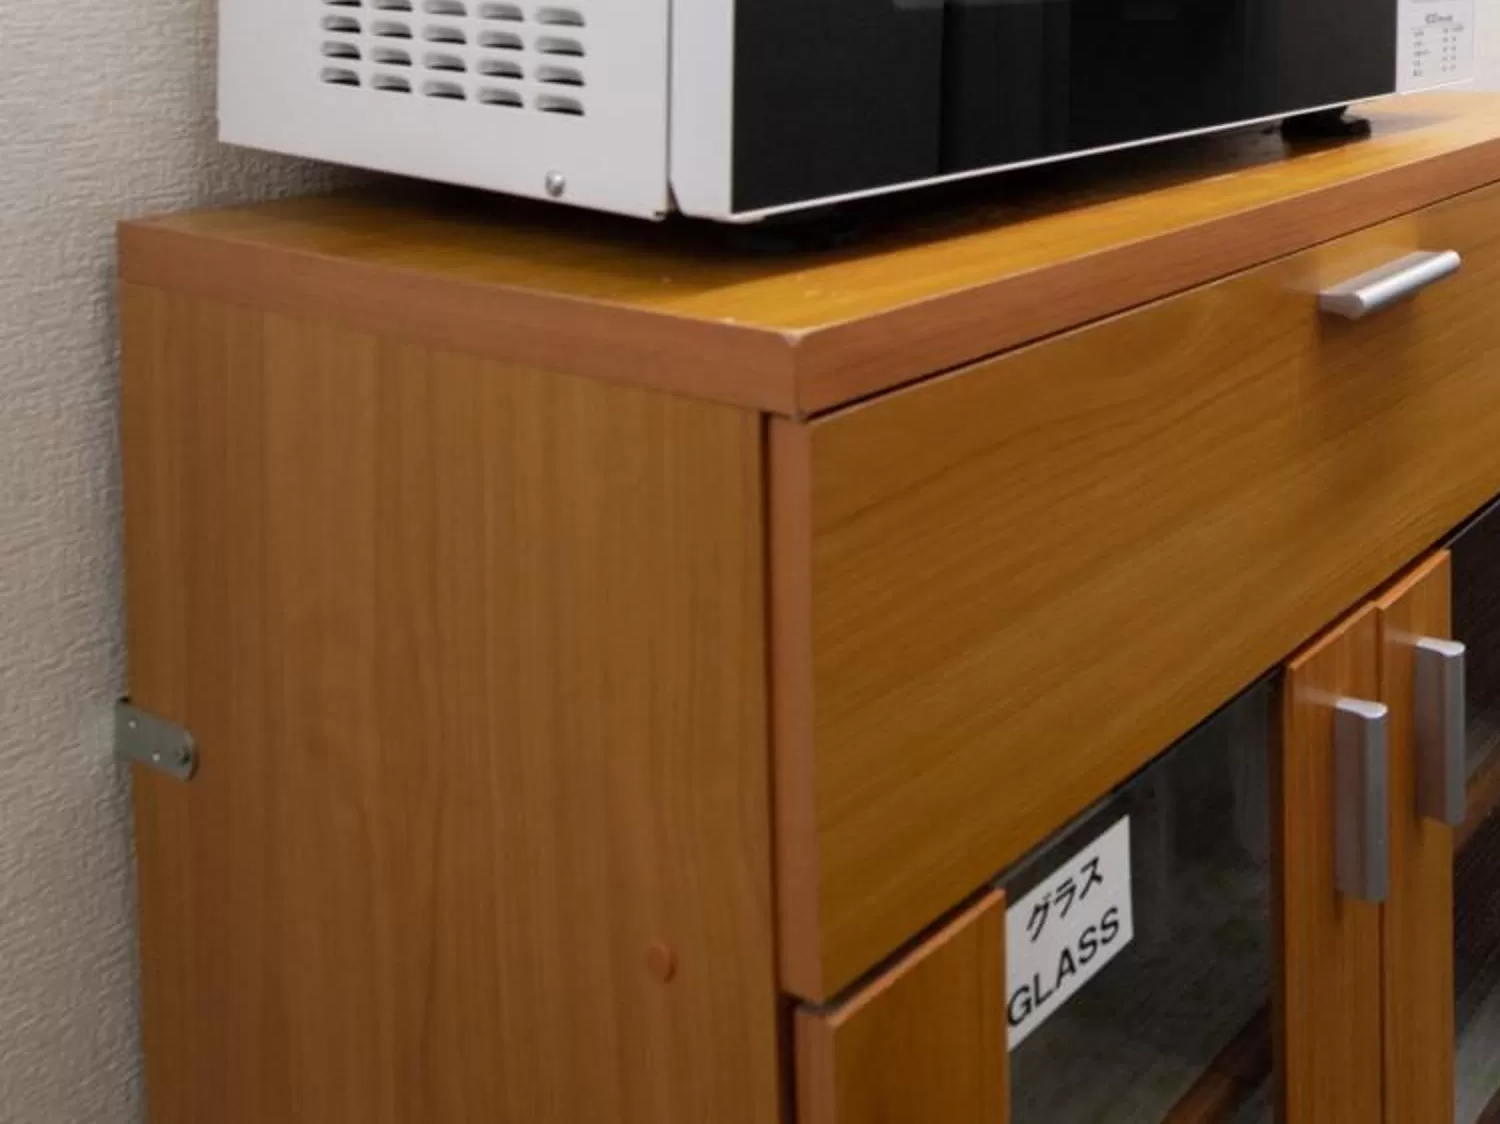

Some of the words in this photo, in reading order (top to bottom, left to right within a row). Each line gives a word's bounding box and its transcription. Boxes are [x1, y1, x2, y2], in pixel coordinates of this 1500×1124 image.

[1026, 856, 1103, 943] グラス
[1006, 906, 1120, 1027] GLASS
